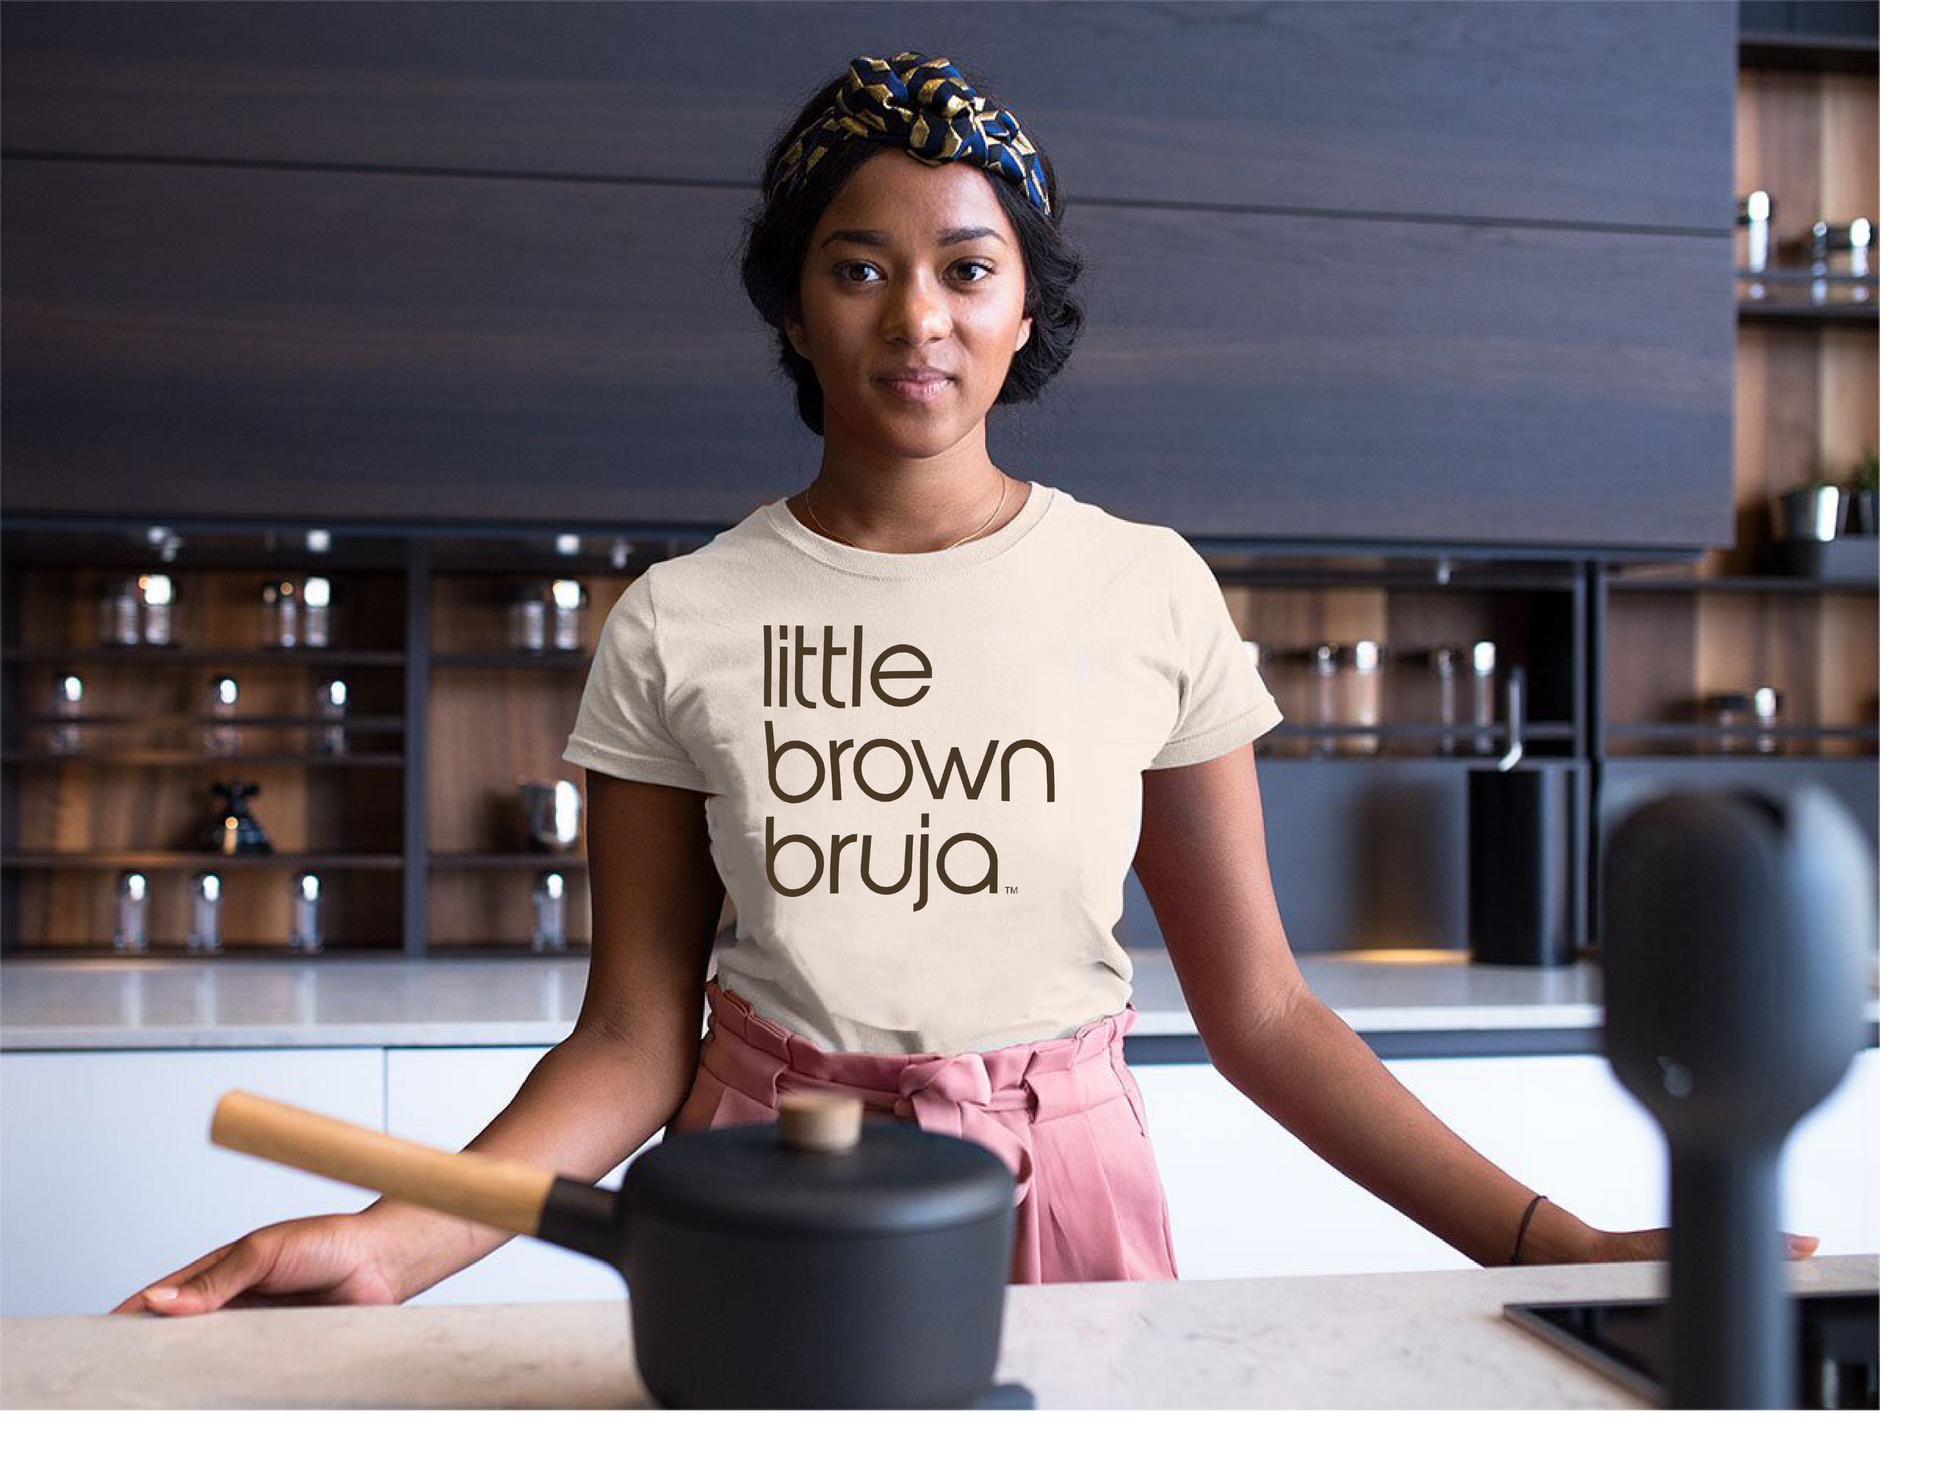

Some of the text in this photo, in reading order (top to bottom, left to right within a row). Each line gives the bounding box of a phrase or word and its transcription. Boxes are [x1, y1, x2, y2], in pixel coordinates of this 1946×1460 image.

[763, 625, 933, 709] little
[764, 720, 1056, 804] brown
[765, 813, 999, 913] bruja
